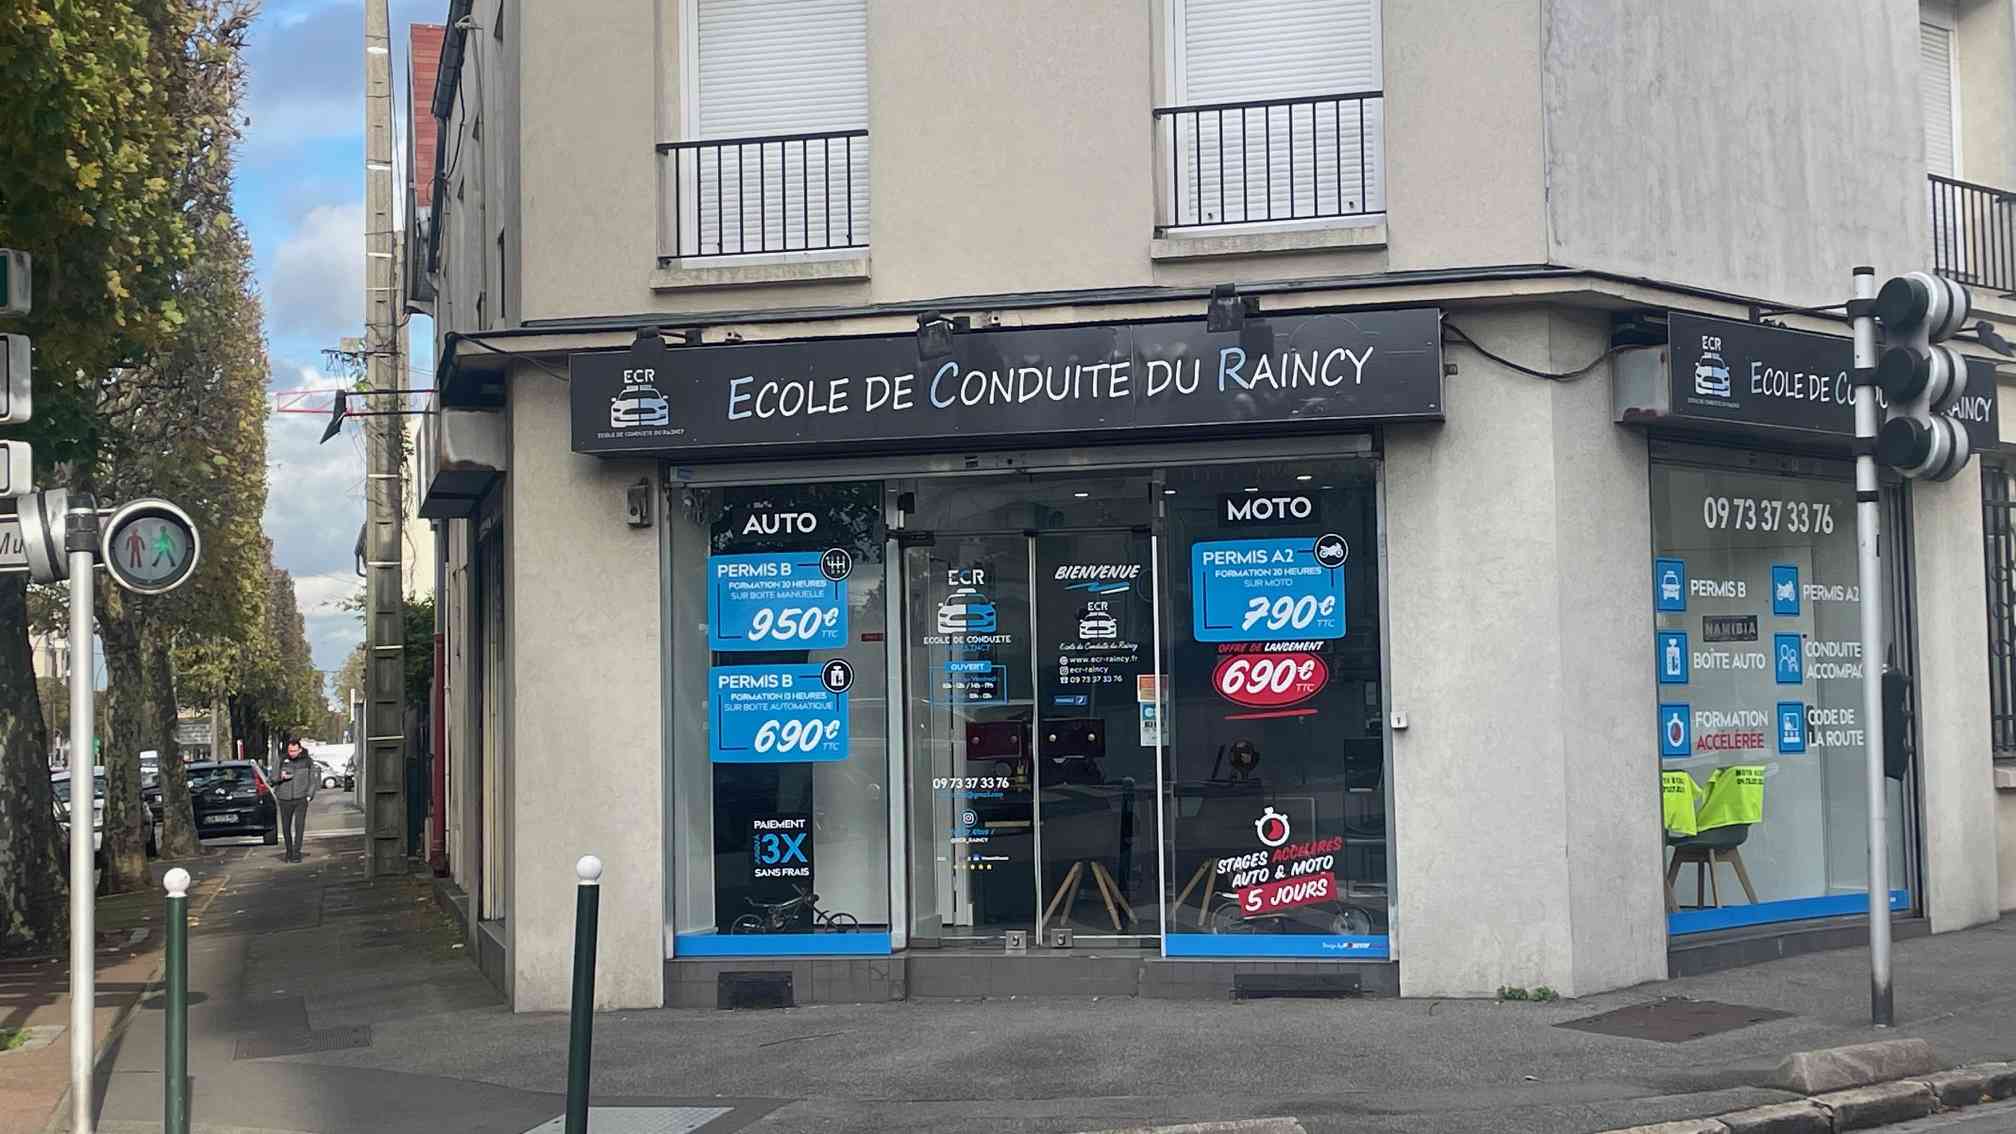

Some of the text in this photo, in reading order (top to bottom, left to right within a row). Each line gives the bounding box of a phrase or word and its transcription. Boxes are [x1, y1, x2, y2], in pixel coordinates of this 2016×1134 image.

[1702, 335, 1721, 351] ECR
[624, 369, 655, 383] ECR
[727, 347, 1374, 420] ECOLE DE CONDUITE DU RAINCY
[1751, 361, 1804, 399] ECOLE
[1809, 375, 1830, 402] DE
[1941, 396, 1993, 422] AINCY
[1227, 496, 1312, 520] MOTO
[1703, 497, 1834, 534] 09 73 37 33 76
[742, 512, 817, 535] AUTO
[1203, 549, 1294, 565] PERMIS A2
[717, 562, 792, 578] PERMIS B
[948, 569, 985, 585] ECR
[1054, 564, 1141, 579] BIENVENUE
[1215, 569, 1271, 578] FORMATION
[1284, 567, 1322, 576] HEURES
[729, 581, 779, 590] FORMATION
[792, 579, 827, 588] HEURES
[1244, 578, 1293, 588] SUR MOTO
[1690, 580, 1746, 598] PERMIS B
[730, 591, 748, 600] SUR
[777, 589, 825, 599] MANUELLE
[1803, 584, 1843, 601] PERMIS
[1088, 601, 1109, 611] ECR
[1241, 595, 1335, 632] 790€
[748, 606, 839, 641] 950€
[1317, 619, 1335, 628] TTC
[822, 630, 839, 639] TTC
[923, 636, 950, 645] ECOLE
[967, 634, 1013, 644] CONDUITE
[1264, 641, 1324, 652] LANCEMENT
[1805, 641, 1862, 657] CONDUITE
[1069, 655, 1138, 663] www.ecr-raincy.fr
[1693, 647, 1766, 669] BOÎTE AUTO
[951, 663, 985, 671] OUVERT
[718, 673, 793, 689] PERMIS B
[1222, 658, 1315, 694] 690€
[1296, 683, 1315, 692] TTC
[730, 692, 781, 701] FORMATION
[793, 691, 827, 700] HEURES
[724, 702, 742, 712] SUR
[770, 701, 833, 711] AUTOMATIQUE
[1695, 711, 1768, 728] FORMATION
[1808, 709, 1855, 725] CODE DE
[754, 718, 840, 753] 690€
[1809, 730, 1864, 747] LA ROUTE
[822, 742, 840, 750] TTC
[933, 777, 1010, 789] 09 73 37 33 76
[754, 819, 806, 829] PAIEMENT
[761, 833, 808, 864] 3X
[1216, 851, 1268, 874] STAGES
[754, 867, 810, 878] SANS FRAIS
[1232, 855, 1334, 888] AUTO & MOTO
[1245, 878, 1329, 911] 5 JOURS
